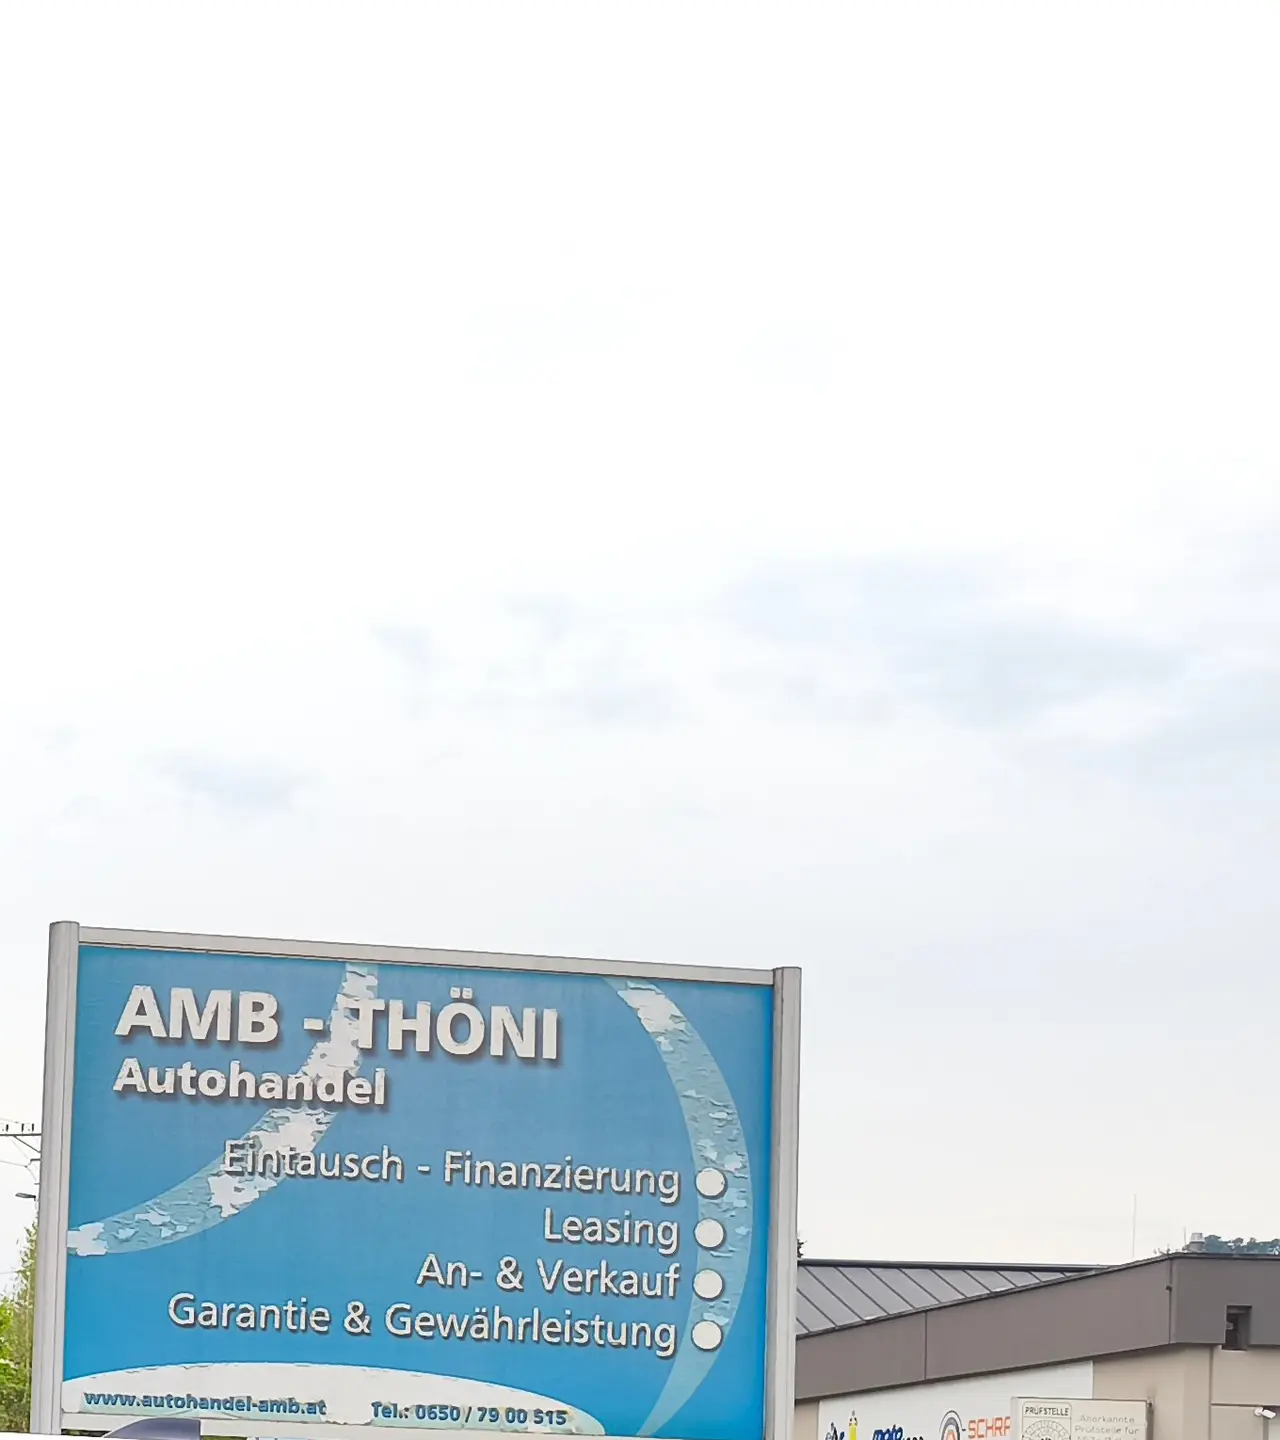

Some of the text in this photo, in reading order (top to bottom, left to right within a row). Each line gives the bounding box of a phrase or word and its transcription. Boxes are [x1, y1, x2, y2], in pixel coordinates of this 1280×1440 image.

[114, 984, 279, 1044] AMB
[353, 986, 558, 1060] THÖNI
[113, 1057, 386, 1105] Autohandel
[222, 1139, 405, 1182] Eintausch
[443, 1150, 681, 1203] Finanzierung
[543, 1207, 679, 1255] Leasing
[416, 1253, 682, 1298] An- & Verkauf
[167, 1293, 678, 1358] Garantie & Gewährleistung
[83, 1392, 327, 1415] www.autohandel-amb.at
[415, 1404, 460, 1421] 0650
[477, 1407, 500, 1422] 79
[505, 1407, 528, 1424] 00
